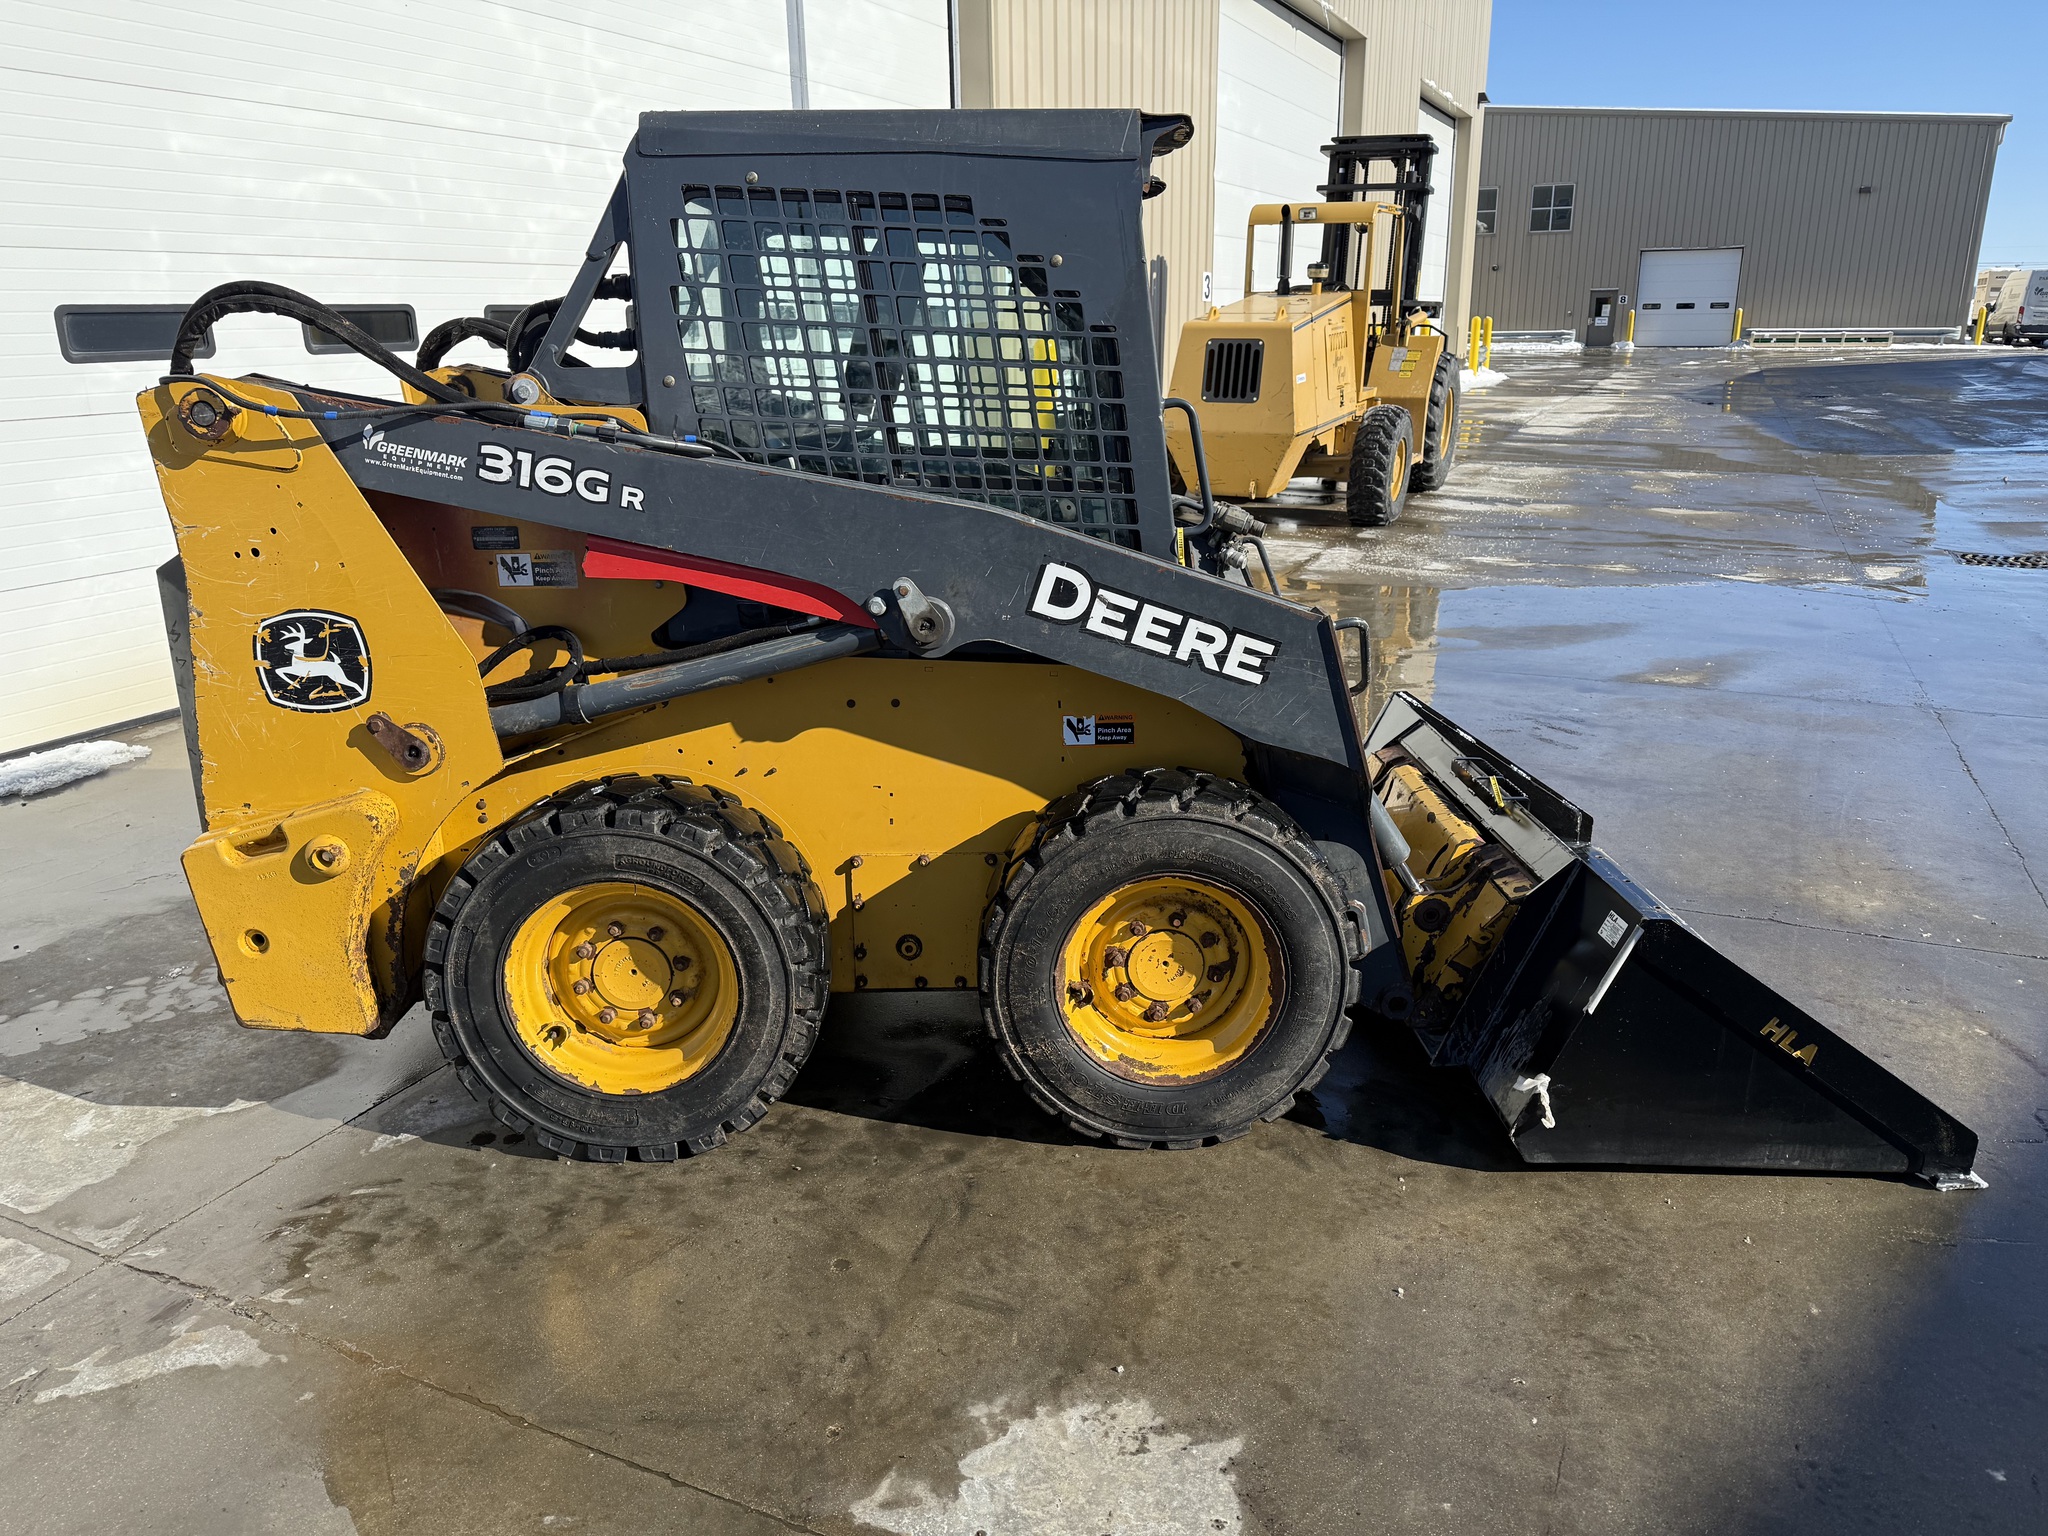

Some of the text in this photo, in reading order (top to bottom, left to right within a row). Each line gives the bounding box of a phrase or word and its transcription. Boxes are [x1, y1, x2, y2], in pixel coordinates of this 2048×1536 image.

[1204, 275, 1211, 299] 3
[1620, 295, 1627, 304] 8
[377, 442, 468, 468] GREENMARK
[383, 454, 459, 473] EQUIPMENT
[478, 444, 646, 511] 316G R
[1031, 562, 1276, 685] DEERE
[1760, 1016, 1819, 1067] HLA
